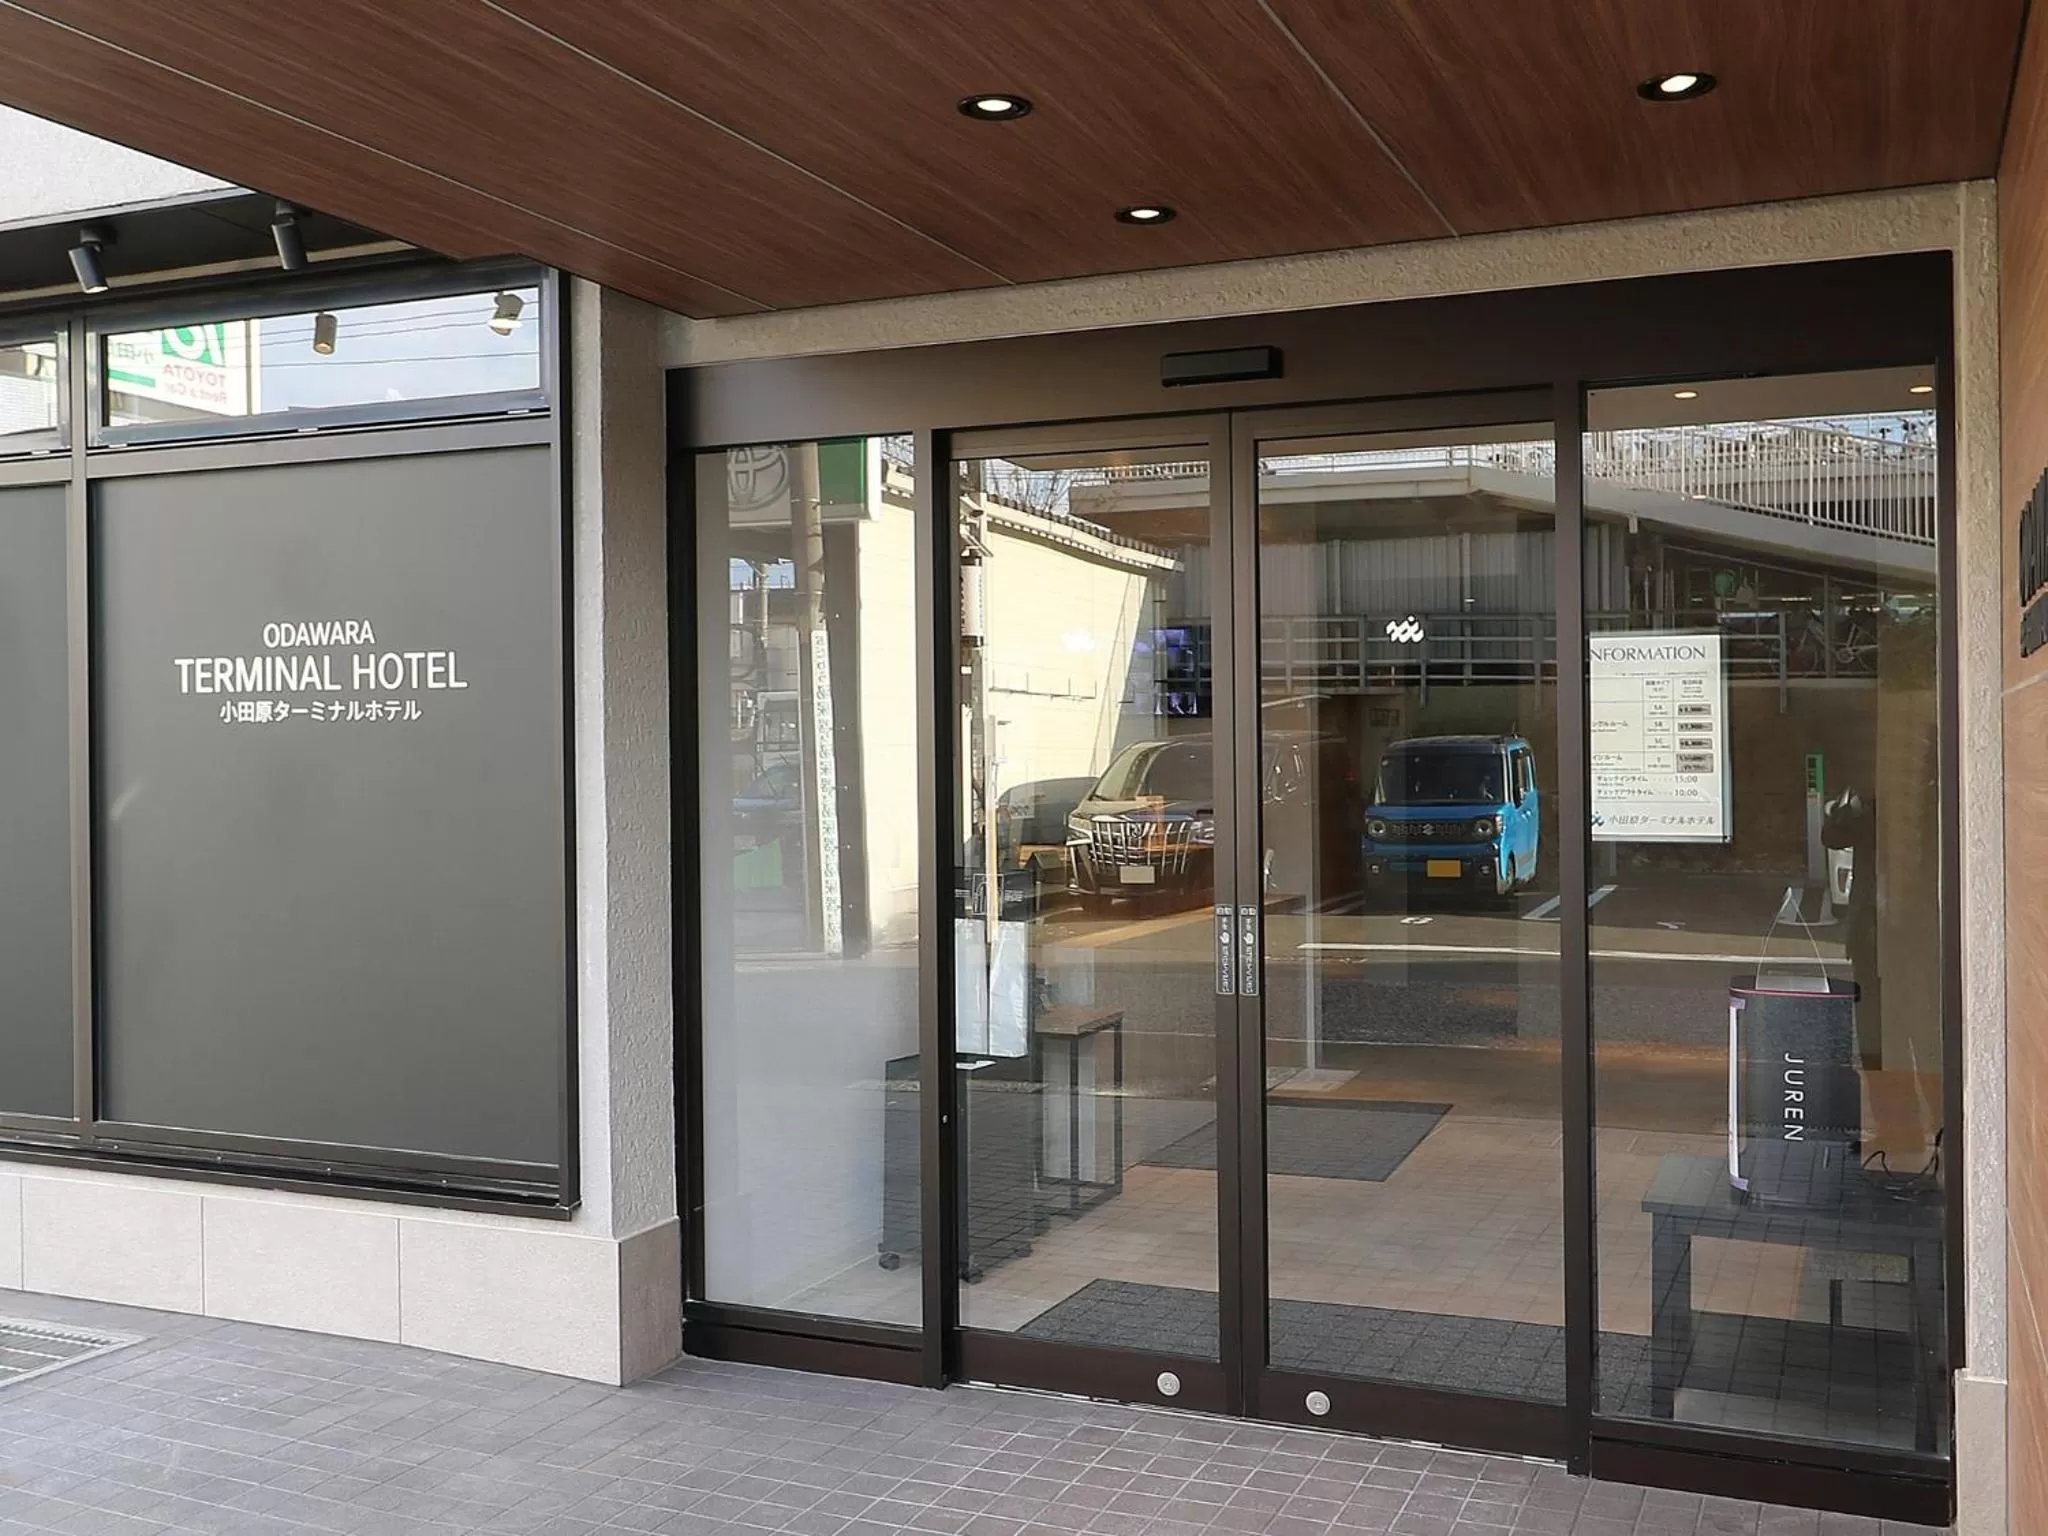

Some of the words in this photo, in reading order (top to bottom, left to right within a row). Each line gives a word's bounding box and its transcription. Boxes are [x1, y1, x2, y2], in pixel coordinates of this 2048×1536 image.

[263, 620, 375, 648] ODAWARA
[1590, 645, 1706, 662] NFORMATION
[174, 655, 342, 694] TERMINAL
[352, 651, 468, 690] HOTEL
[219, 701, 422, 723] 小田原ターミナルホテル
[1783, 1052, 1805, 1142] JUREN
